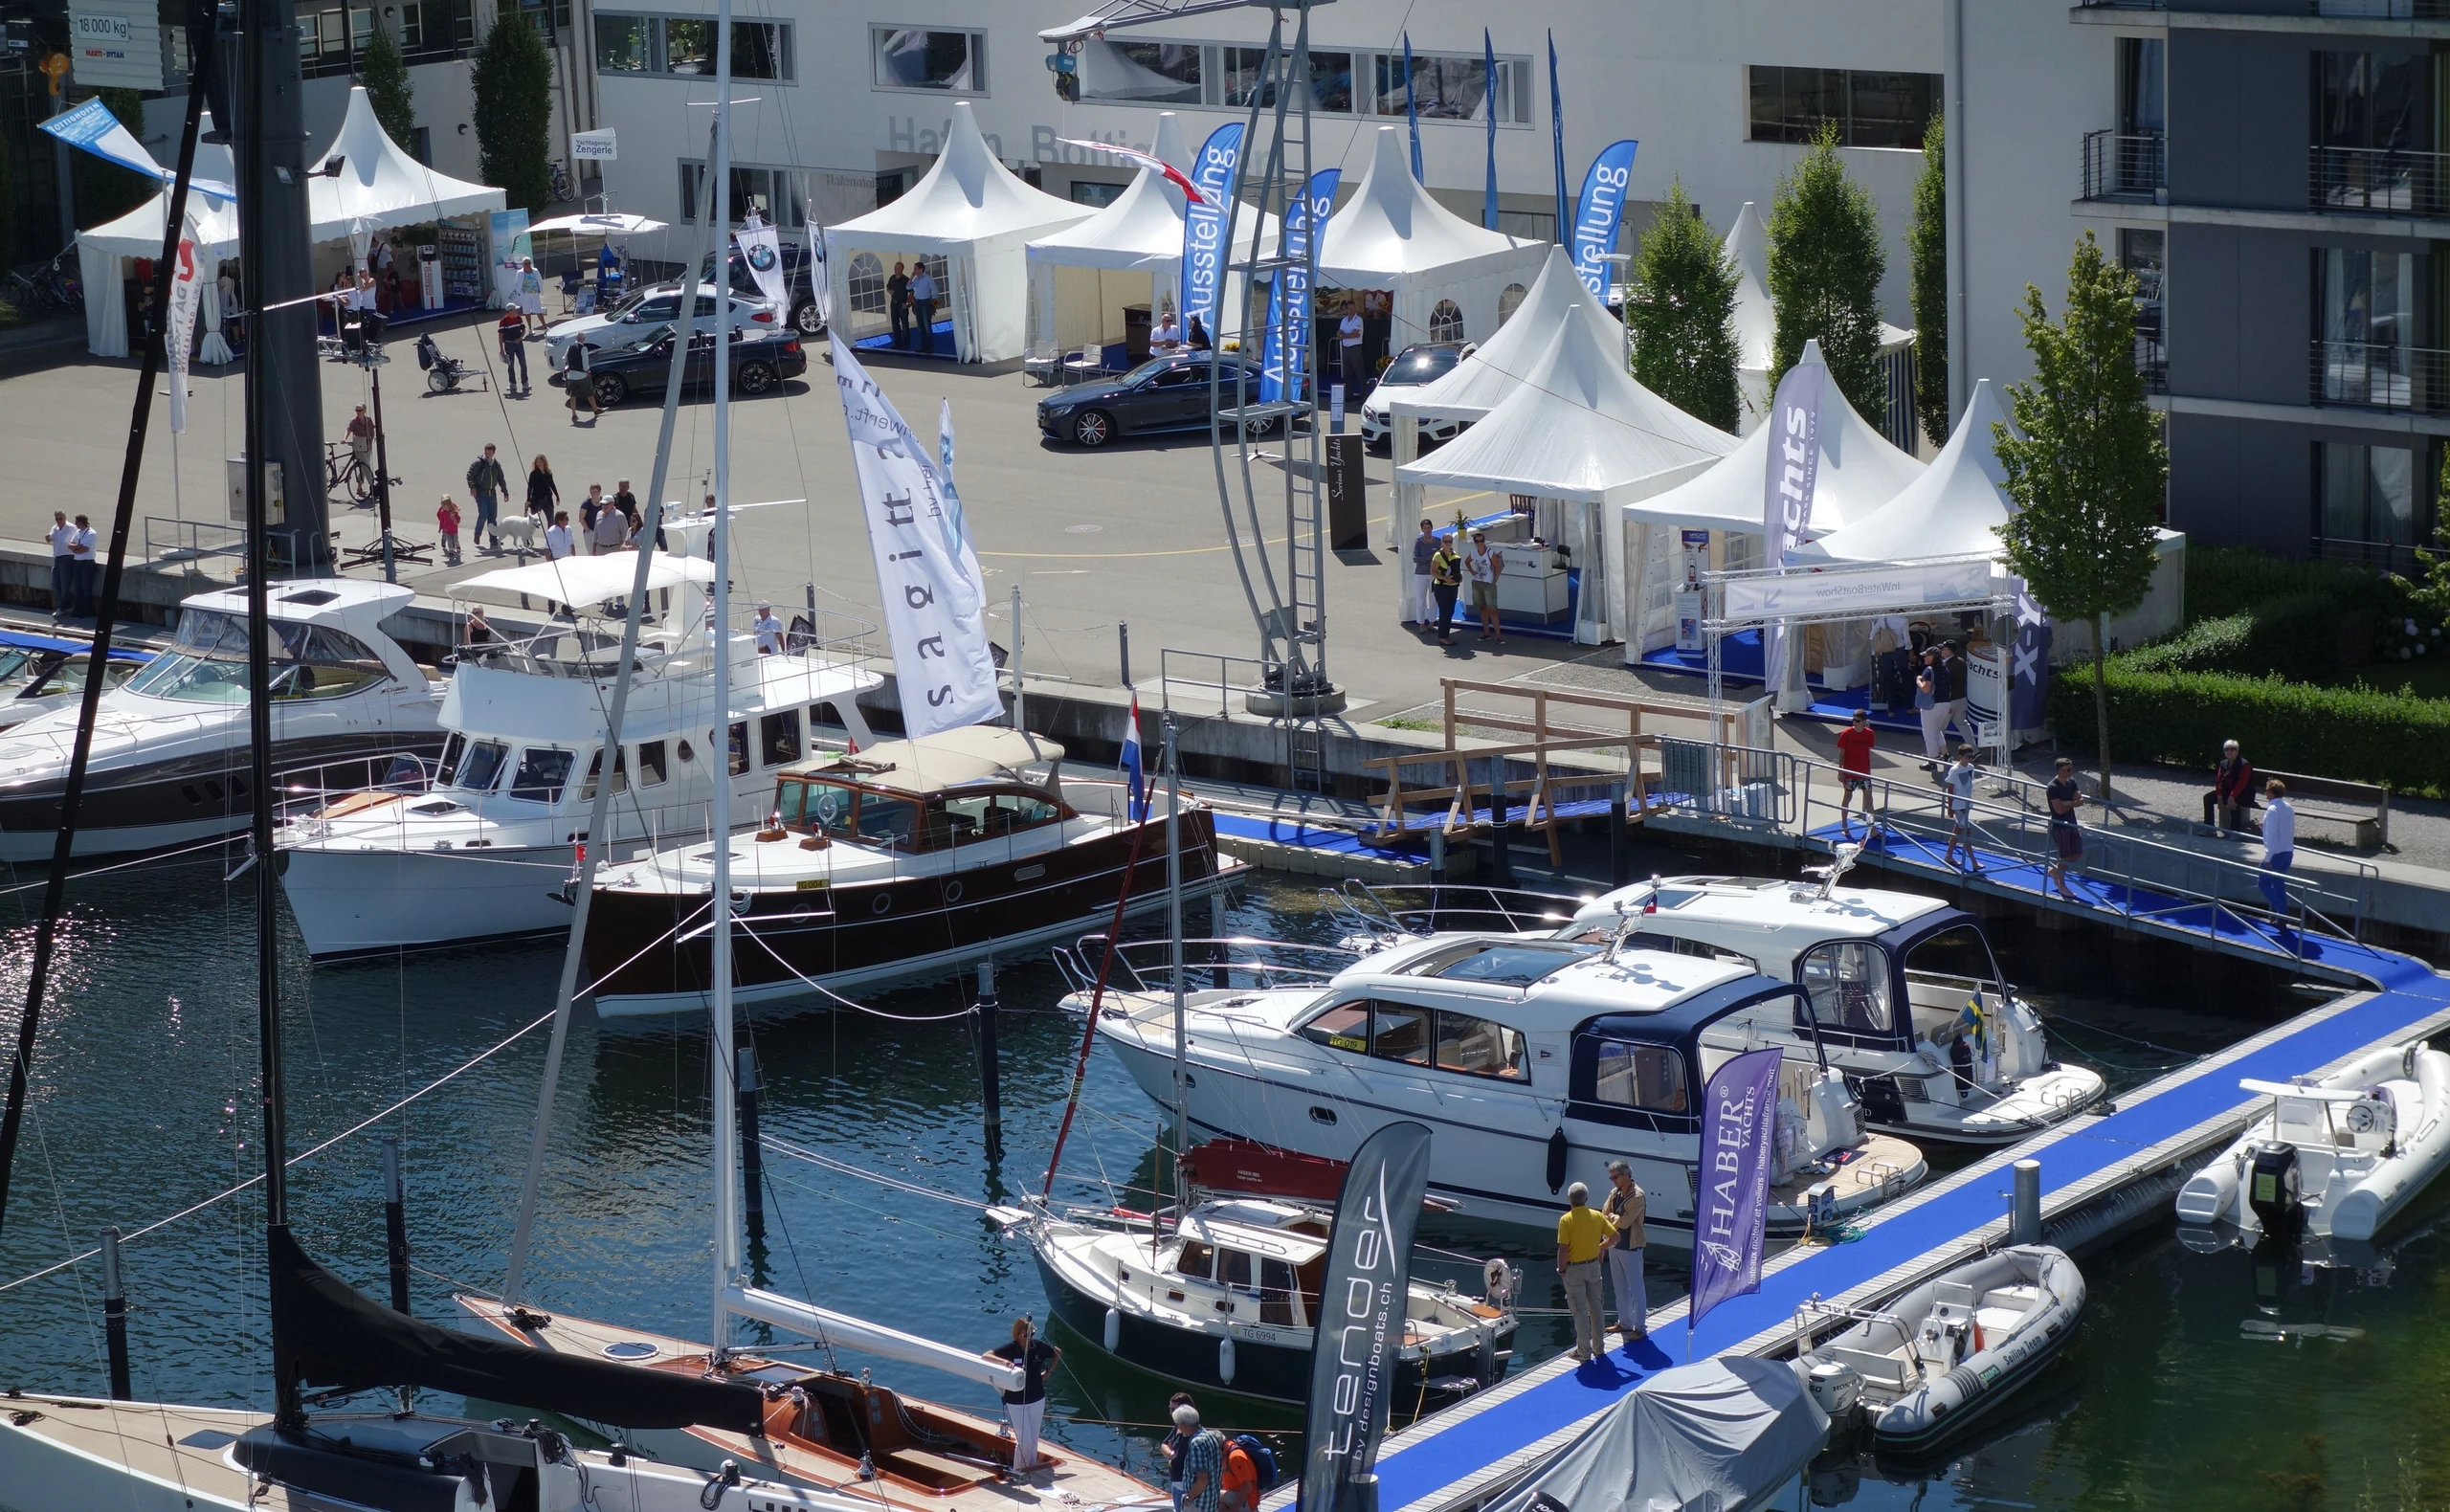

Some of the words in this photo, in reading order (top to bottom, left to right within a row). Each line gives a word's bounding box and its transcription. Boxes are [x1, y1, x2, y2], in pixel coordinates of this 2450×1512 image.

[79, 18, 90, 33] 18
[93, 19, 111, 33] 000
[114, 21, 126, 37] kg
[576, 145, 612, 155] Zengerle
[889, 116, 1002, 159] Hafn
[1575, 164, 1628, 295] stellung
[1330, 438, 1346, 467] Yachts
[1330, 469, 1344, 501] Serious
[1806, 450, 1815, 488] SINCE
[1332, 1036, 1343, 1046] TG
[1344, 1039, 1358, 1049] 019
[1742, 1085, 1755, 1148] YACHTS
[1757, 1068, 1775, 1170] haberyachtsfrance.com
[1755, 1177, 1765, 1207] voiliers
[1754, 1209, 1762, 1218] et
[1751, 1218, 1761, 1250] moteur
[1748, 1251, 1757, 1285] bateaux
[1243, 1328, 1254, 1339] TG
[1256, 1330, 1276, 1342] 6994
[2003, 1345, 2027, 1366] Sailing
[2024, 1335, 2043, 1350] Team
[1351, 1439, 1367, 1461] by
[1359, 1281, 1392, 1433] designboats.ch
